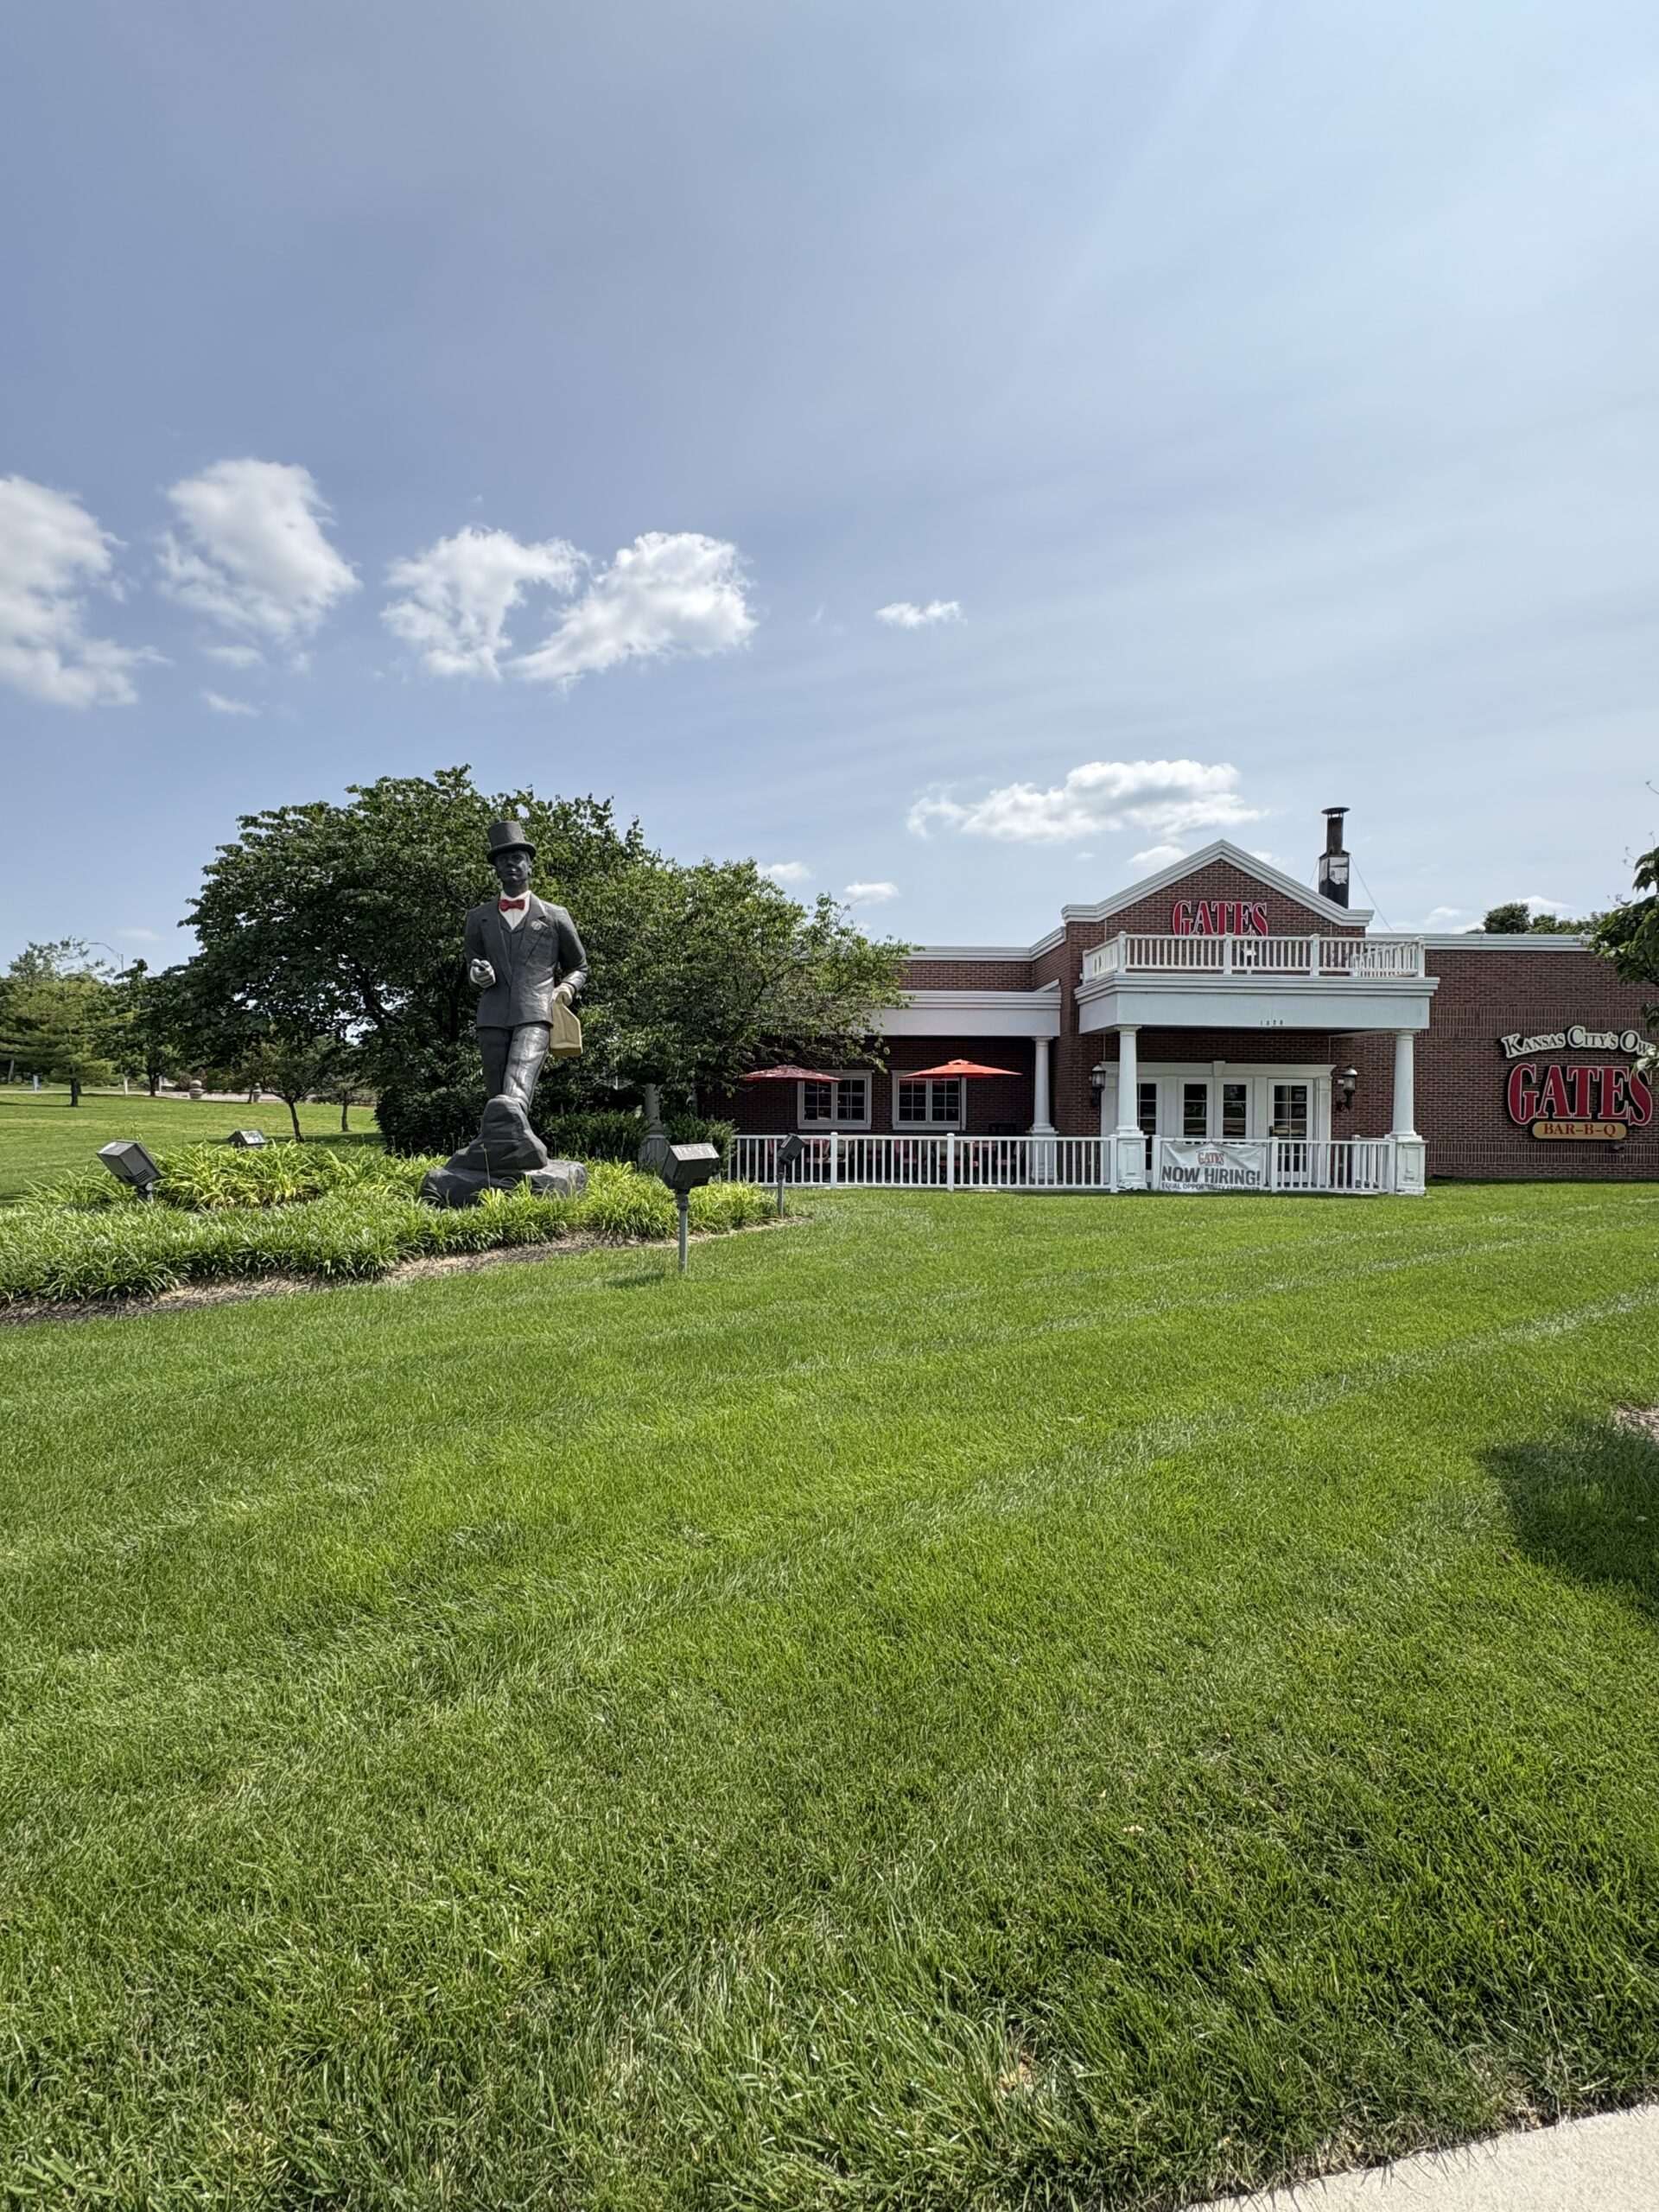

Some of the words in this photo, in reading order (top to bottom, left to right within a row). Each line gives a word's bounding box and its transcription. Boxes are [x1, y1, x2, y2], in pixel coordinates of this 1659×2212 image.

[1172, 899, 1268, 937] GATES
[1503, 1034, 1564, 1057] KANSAS
[1621, 1031, 1656, 1053] OW
[1509, 1063, 1653, 1126] GATES
[1543, 1122, 1617, 1138] BAR-B-Q
[1198, 1152, 1224, 1166] GATES
[1161, 1166, 1200, 1183] NOW
[1205, 1169, 1261, 1185] HIRING!
